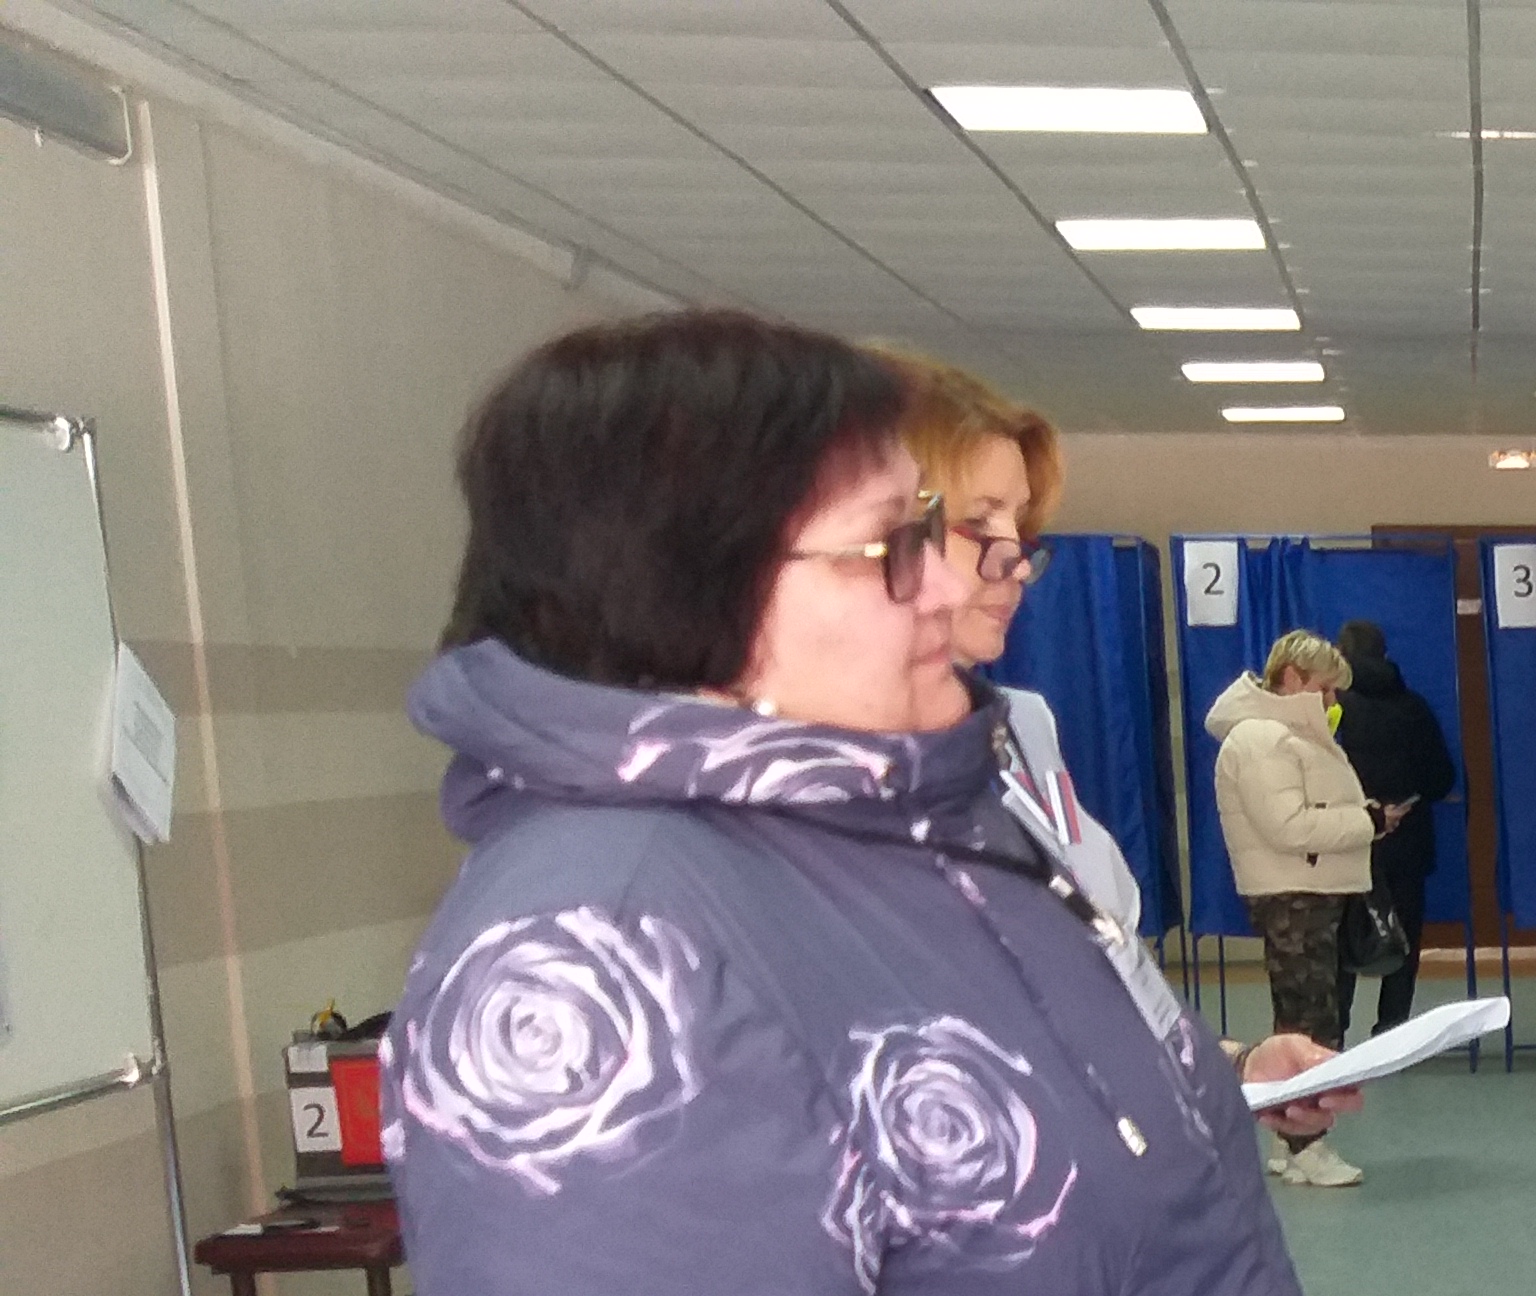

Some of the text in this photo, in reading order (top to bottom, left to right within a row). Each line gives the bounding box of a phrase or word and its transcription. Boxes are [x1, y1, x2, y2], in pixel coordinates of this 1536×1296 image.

[1202, 562, 1225, 595] 2
[1513, 564, 1533, 598] 3
[303, 1102, 329, 1139] 2
